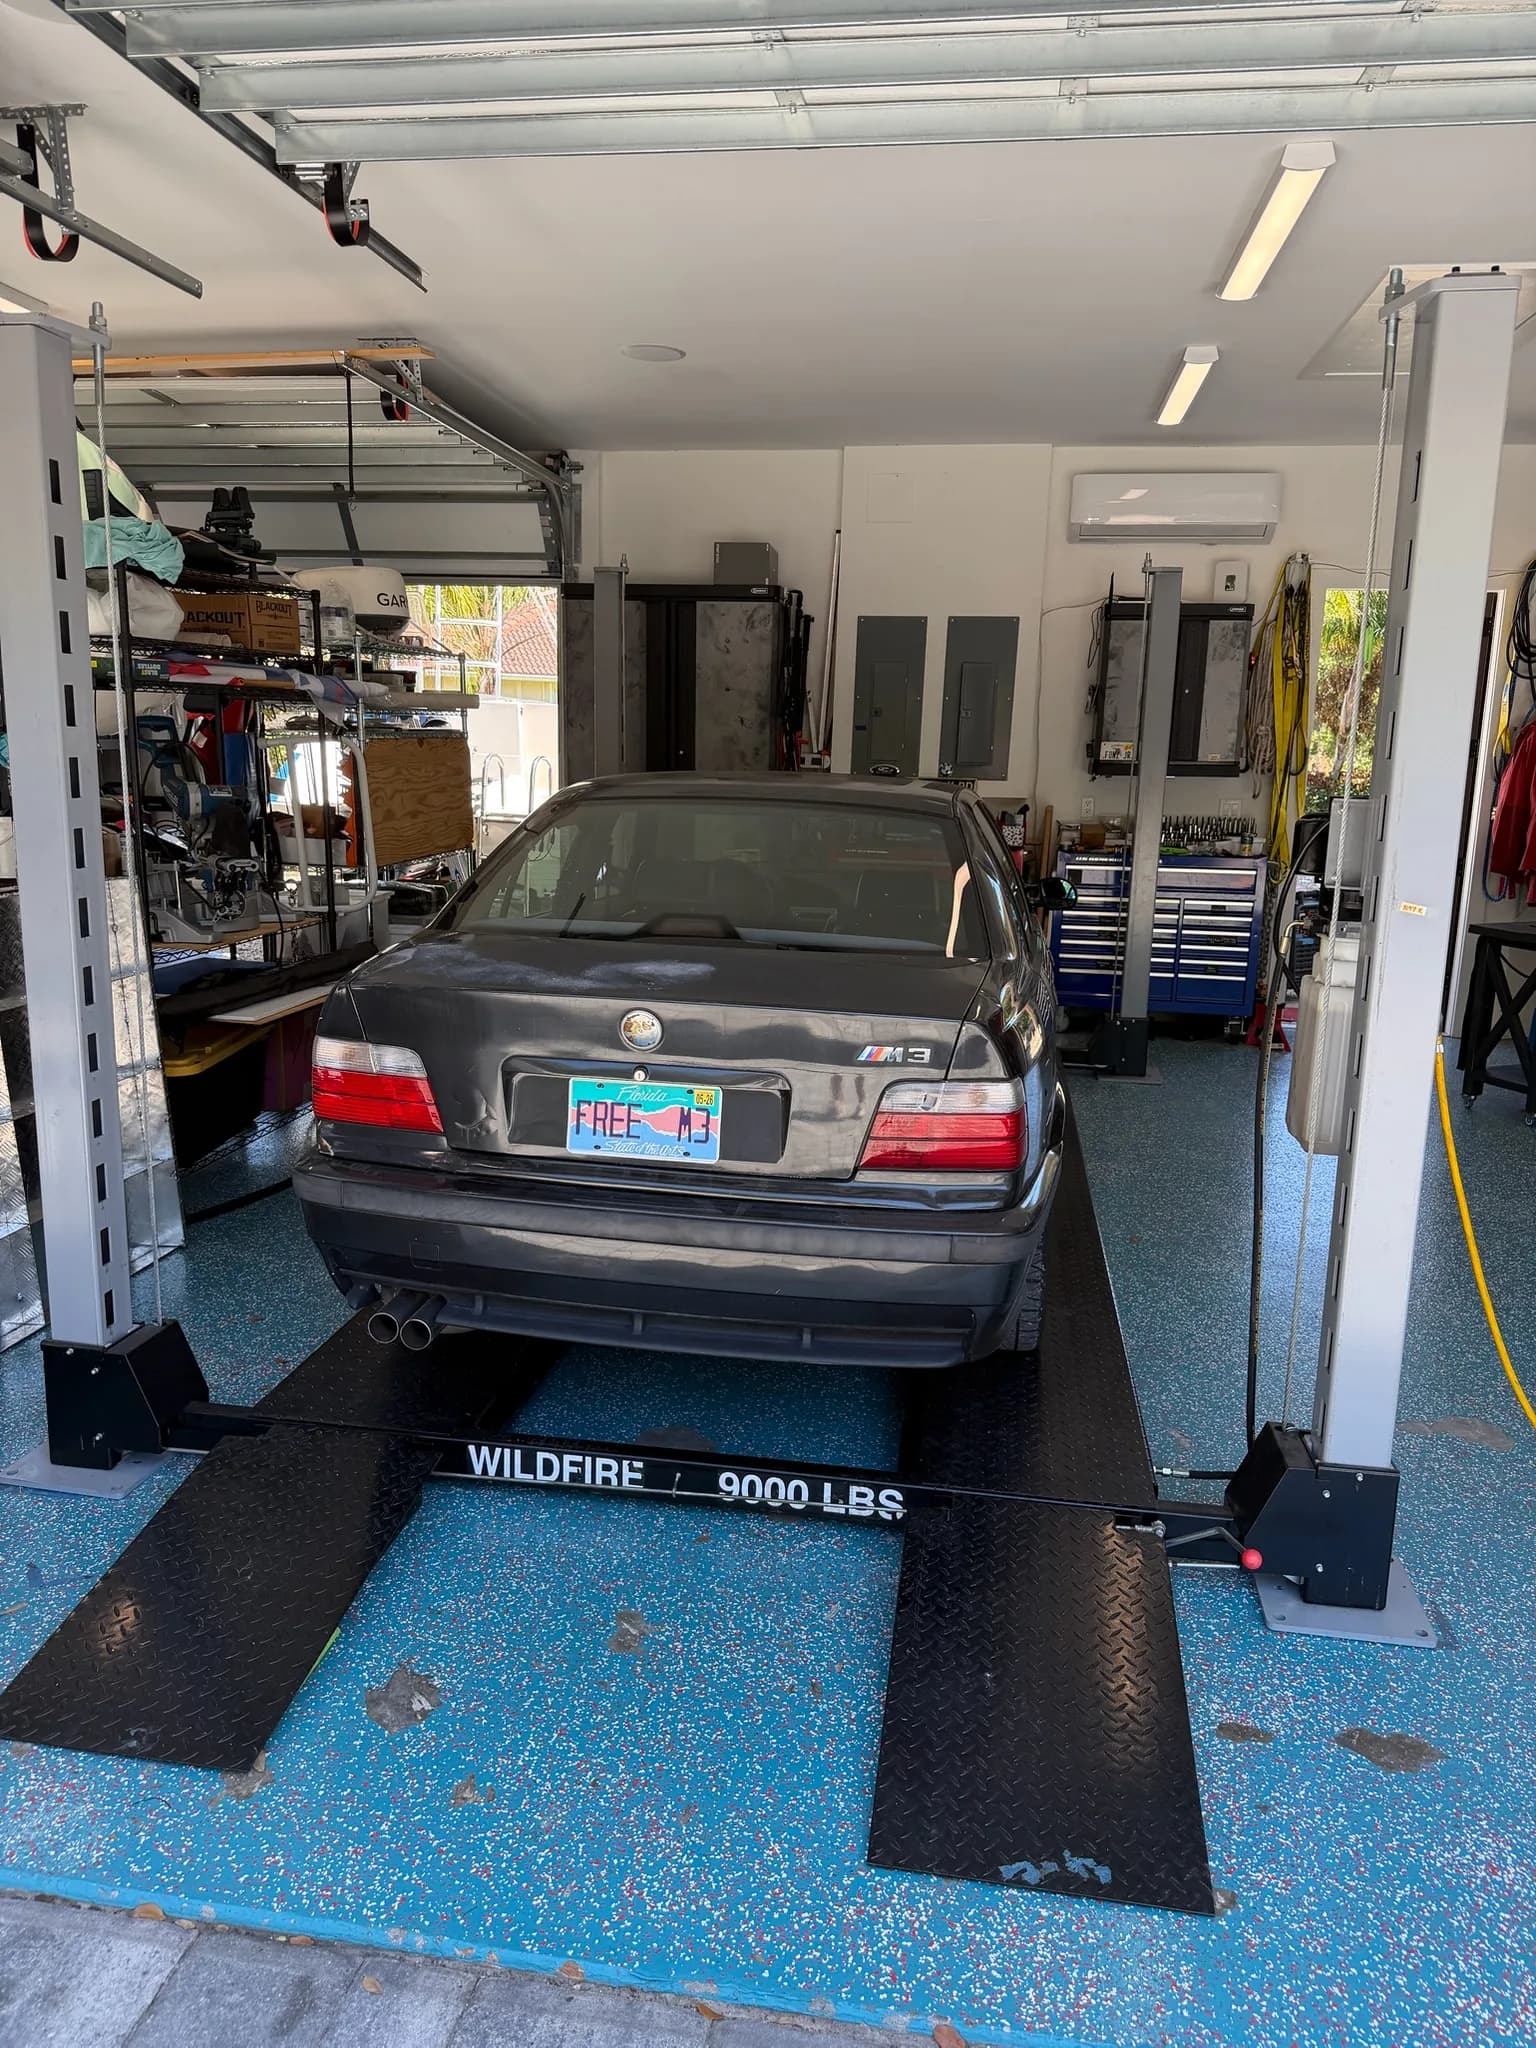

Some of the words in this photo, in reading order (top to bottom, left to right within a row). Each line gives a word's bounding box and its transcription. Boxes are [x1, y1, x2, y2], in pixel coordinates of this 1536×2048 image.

[255, 600, 293, 617] BLACKOUT
[376, 592, 409, 609] GAR
[183, 610, 245, 629] ACKOUT
[617, 1085, 672, 1102] Florida
[695, 1093, 714, 1106] 05-26
[575, 1099, 643, 1140] FREE
[677, 1106, 712, 1145] M3
[602, 1140, 635, 1153] State
[467, 1444, 644, 1489] WILDFIRE
[717, 1470, 810, 1511] 9000
[822, 1481, 905, 1521] LBS
